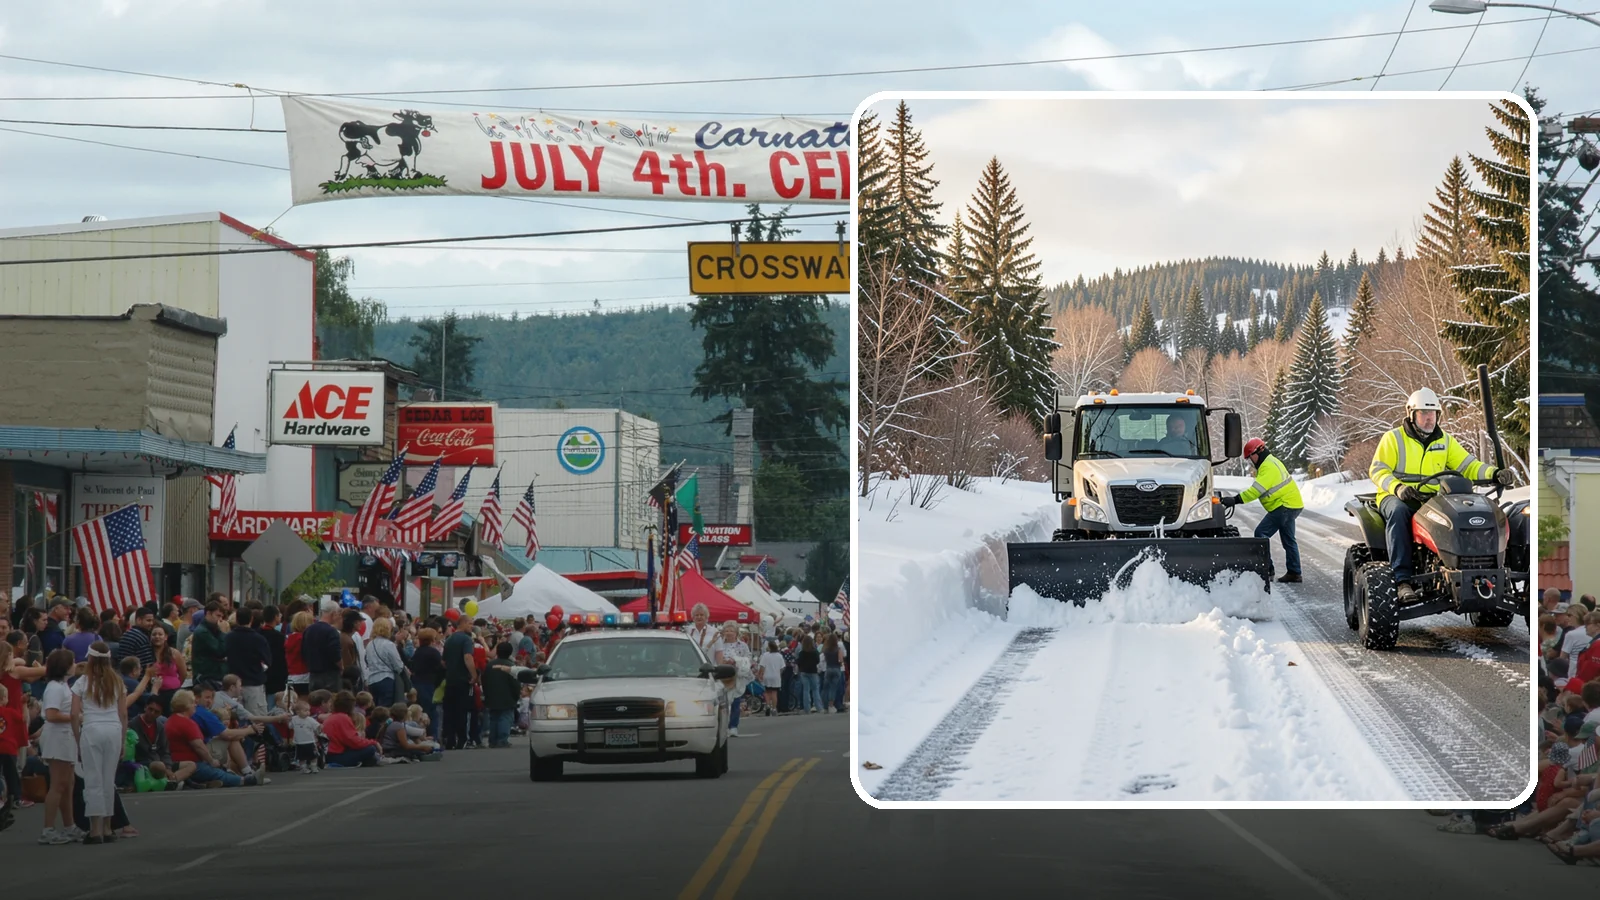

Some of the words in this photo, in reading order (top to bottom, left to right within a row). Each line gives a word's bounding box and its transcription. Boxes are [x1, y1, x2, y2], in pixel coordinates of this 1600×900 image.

[481, 140, 605, 192] JULY
[632, 149, 746, 198] 4th.
[696, 254, 850, 280] CROSSWA
[282, 379, 374, 420] ACE
[405, 409, 452, 422] CEDAR
[283, 421, 371, 437] Hardware
[352, 466, 386, 483] Simpl
[95, 485, 124, 495] Vincent
[125, 486, 136, 495] de
[137, 485, 155, 496] Paul
[688, 526, 741, 535] CRNATION
[699, 535, 730, 544] GLASS
